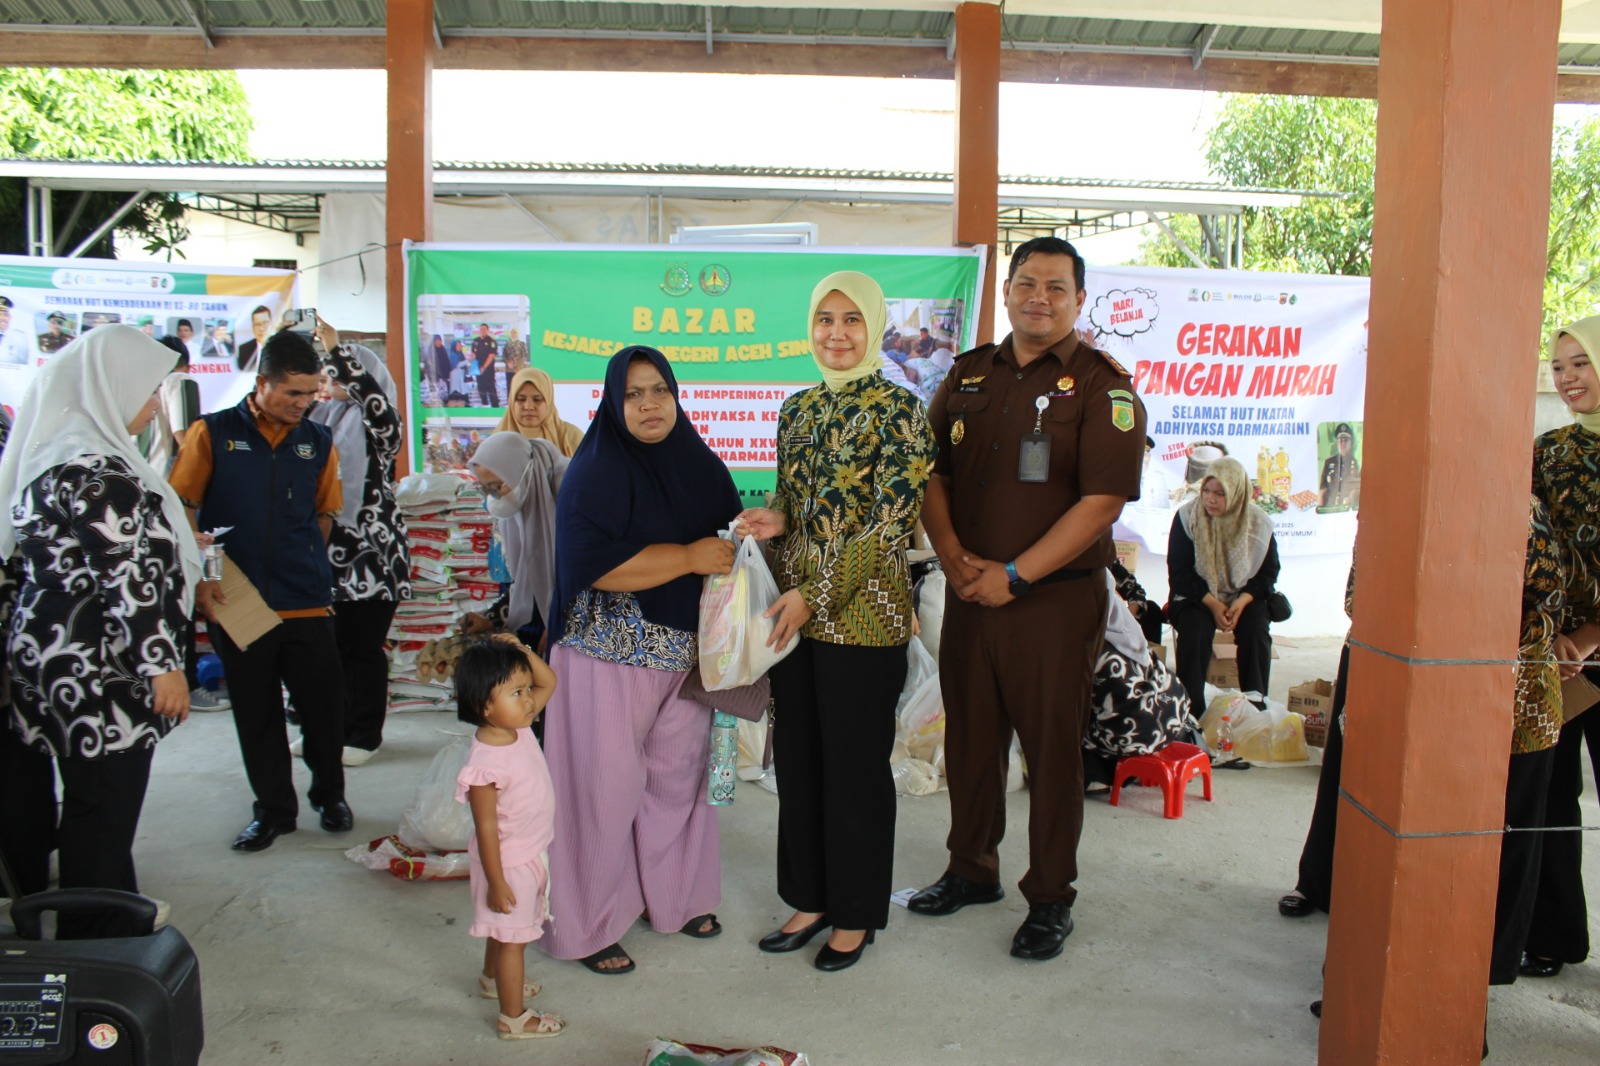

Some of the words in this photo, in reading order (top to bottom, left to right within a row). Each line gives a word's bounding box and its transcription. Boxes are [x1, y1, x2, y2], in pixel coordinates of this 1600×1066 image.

[45, 296, 83, 305] SEMARAK
[85, 297, 101, 306] HUT
[201, 302, 228, 311] TAHUN
[1113, 298, 1133, 312] MARI
[632, 306, 756, 334] BAZAR
[1110, 308, 1143, 326] BELANJA
[1176, 322, 1302, 359] GERAKAN
[725, 343, 772, 362] ACEH
[1133, 360, 1244, 399] PANGAN
[1245, 364, 1337, 399] MURAH
[694, 390, 785, 400] MEMPERINGATI
[1172, 405, 1227, 420] SELAMAT
[1230, 407, 1255, 420] HUT
[1257, 407, 1295, 421] IKATAN
[1154, 421, 1225, 435] ADHIYAKSA
[1227, 422, 1310, 436] DARMAKARINI
